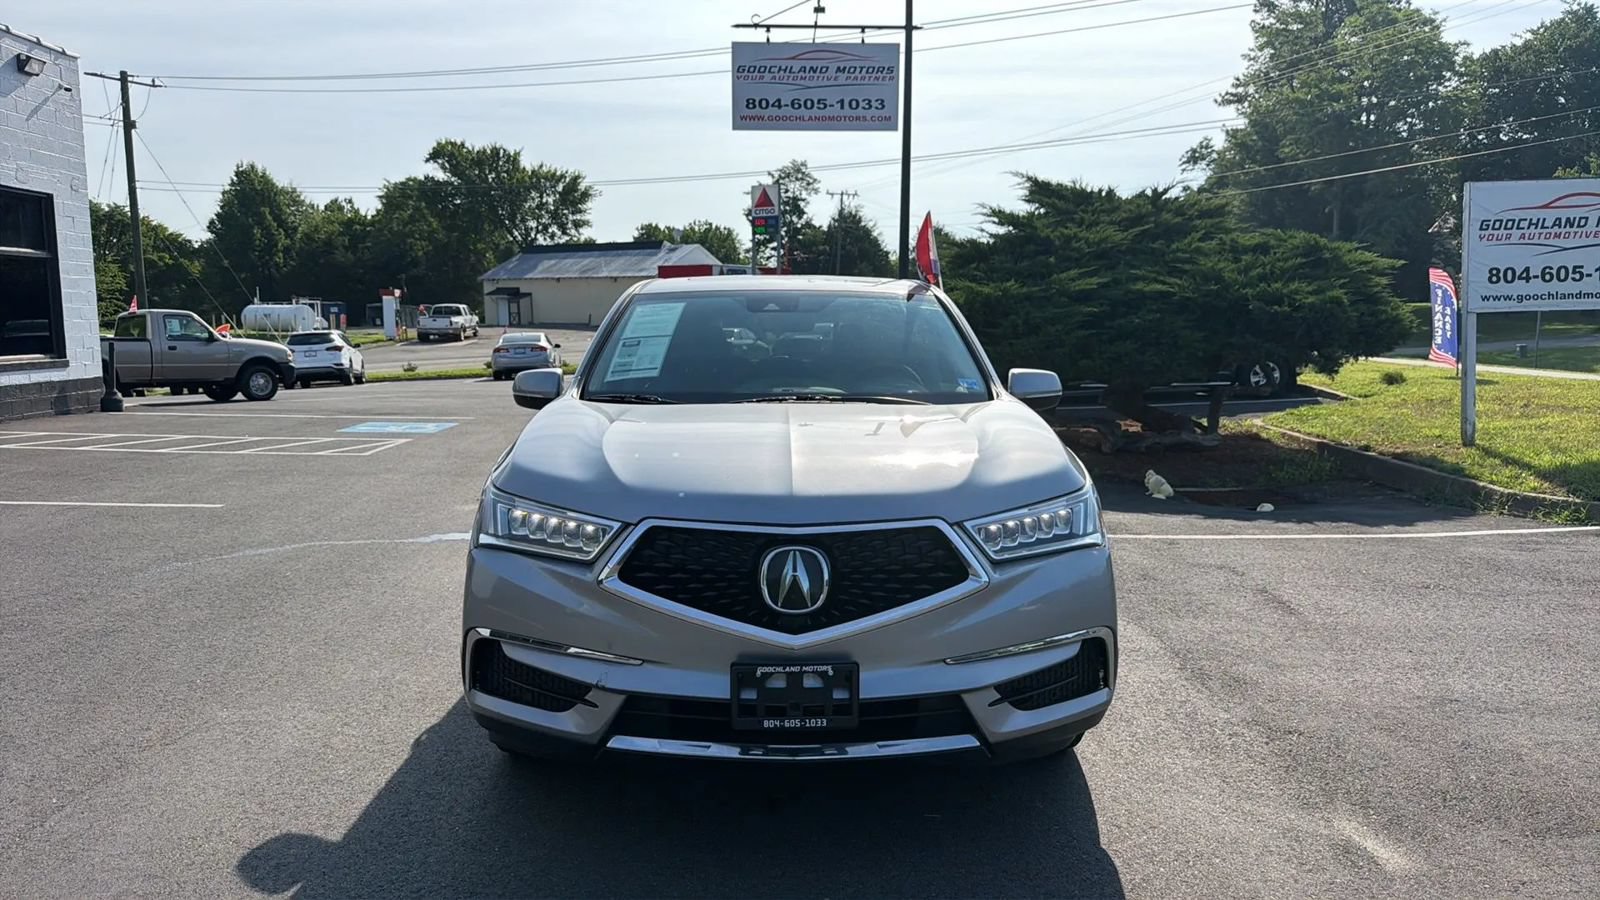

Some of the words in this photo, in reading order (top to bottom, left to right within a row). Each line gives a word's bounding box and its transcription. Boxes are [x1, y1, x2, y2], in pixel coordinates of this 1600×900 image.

[736, 65, 829, 75] GOOCHLAND
[835, 65, 895, 75] MOTORS
[745, 98, 886, 111] 804-605-1033
[739, 114, 892, 122] WWW.GOOCHLANDMOTORS.COM
[754, 208, 776, 216] CITGO
[1478, 216, 1589, 231] GOOCHLAND
[1478, 232, 1513, 242] YOUR
[1518, 230, 1600, 241] AUTOMOTIVE
[801, 665, 832, 673] MOTORS
[763, 718, 827, 728] 804-605-1033
